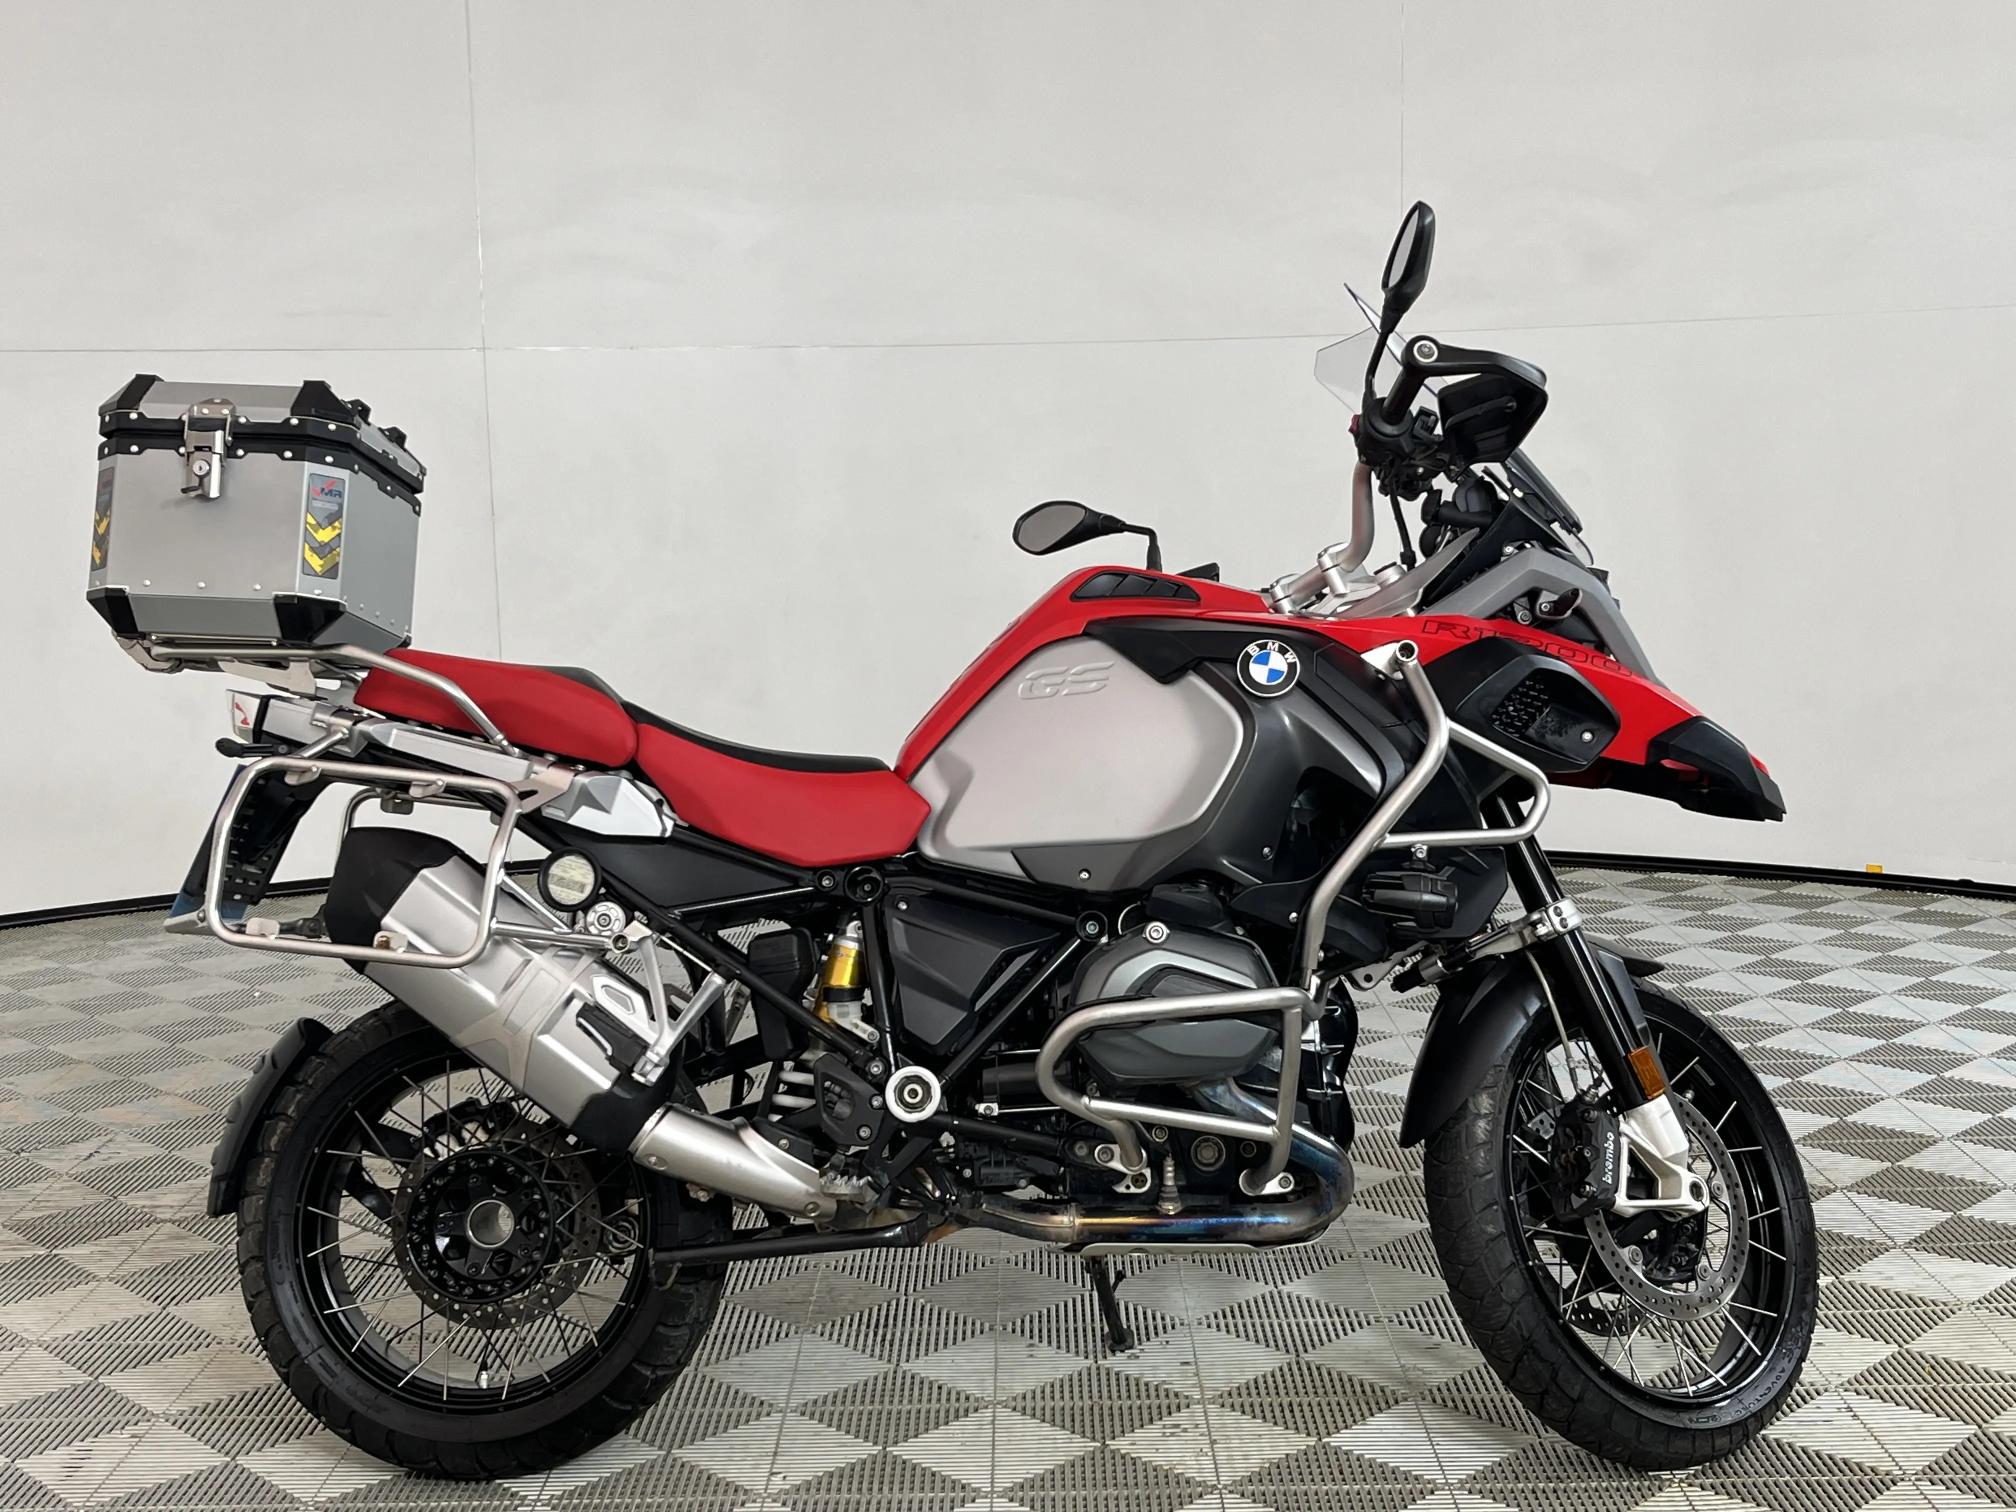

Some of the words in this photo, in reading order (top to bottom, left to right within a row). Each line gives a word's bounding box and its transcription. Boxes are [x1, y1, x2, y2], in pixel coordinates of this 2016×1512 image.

[1247, 641, 1297, 663] BMW
[1018, 661, 1114, 699] GS
[1602, 1131, 1615, 1185] brembo
